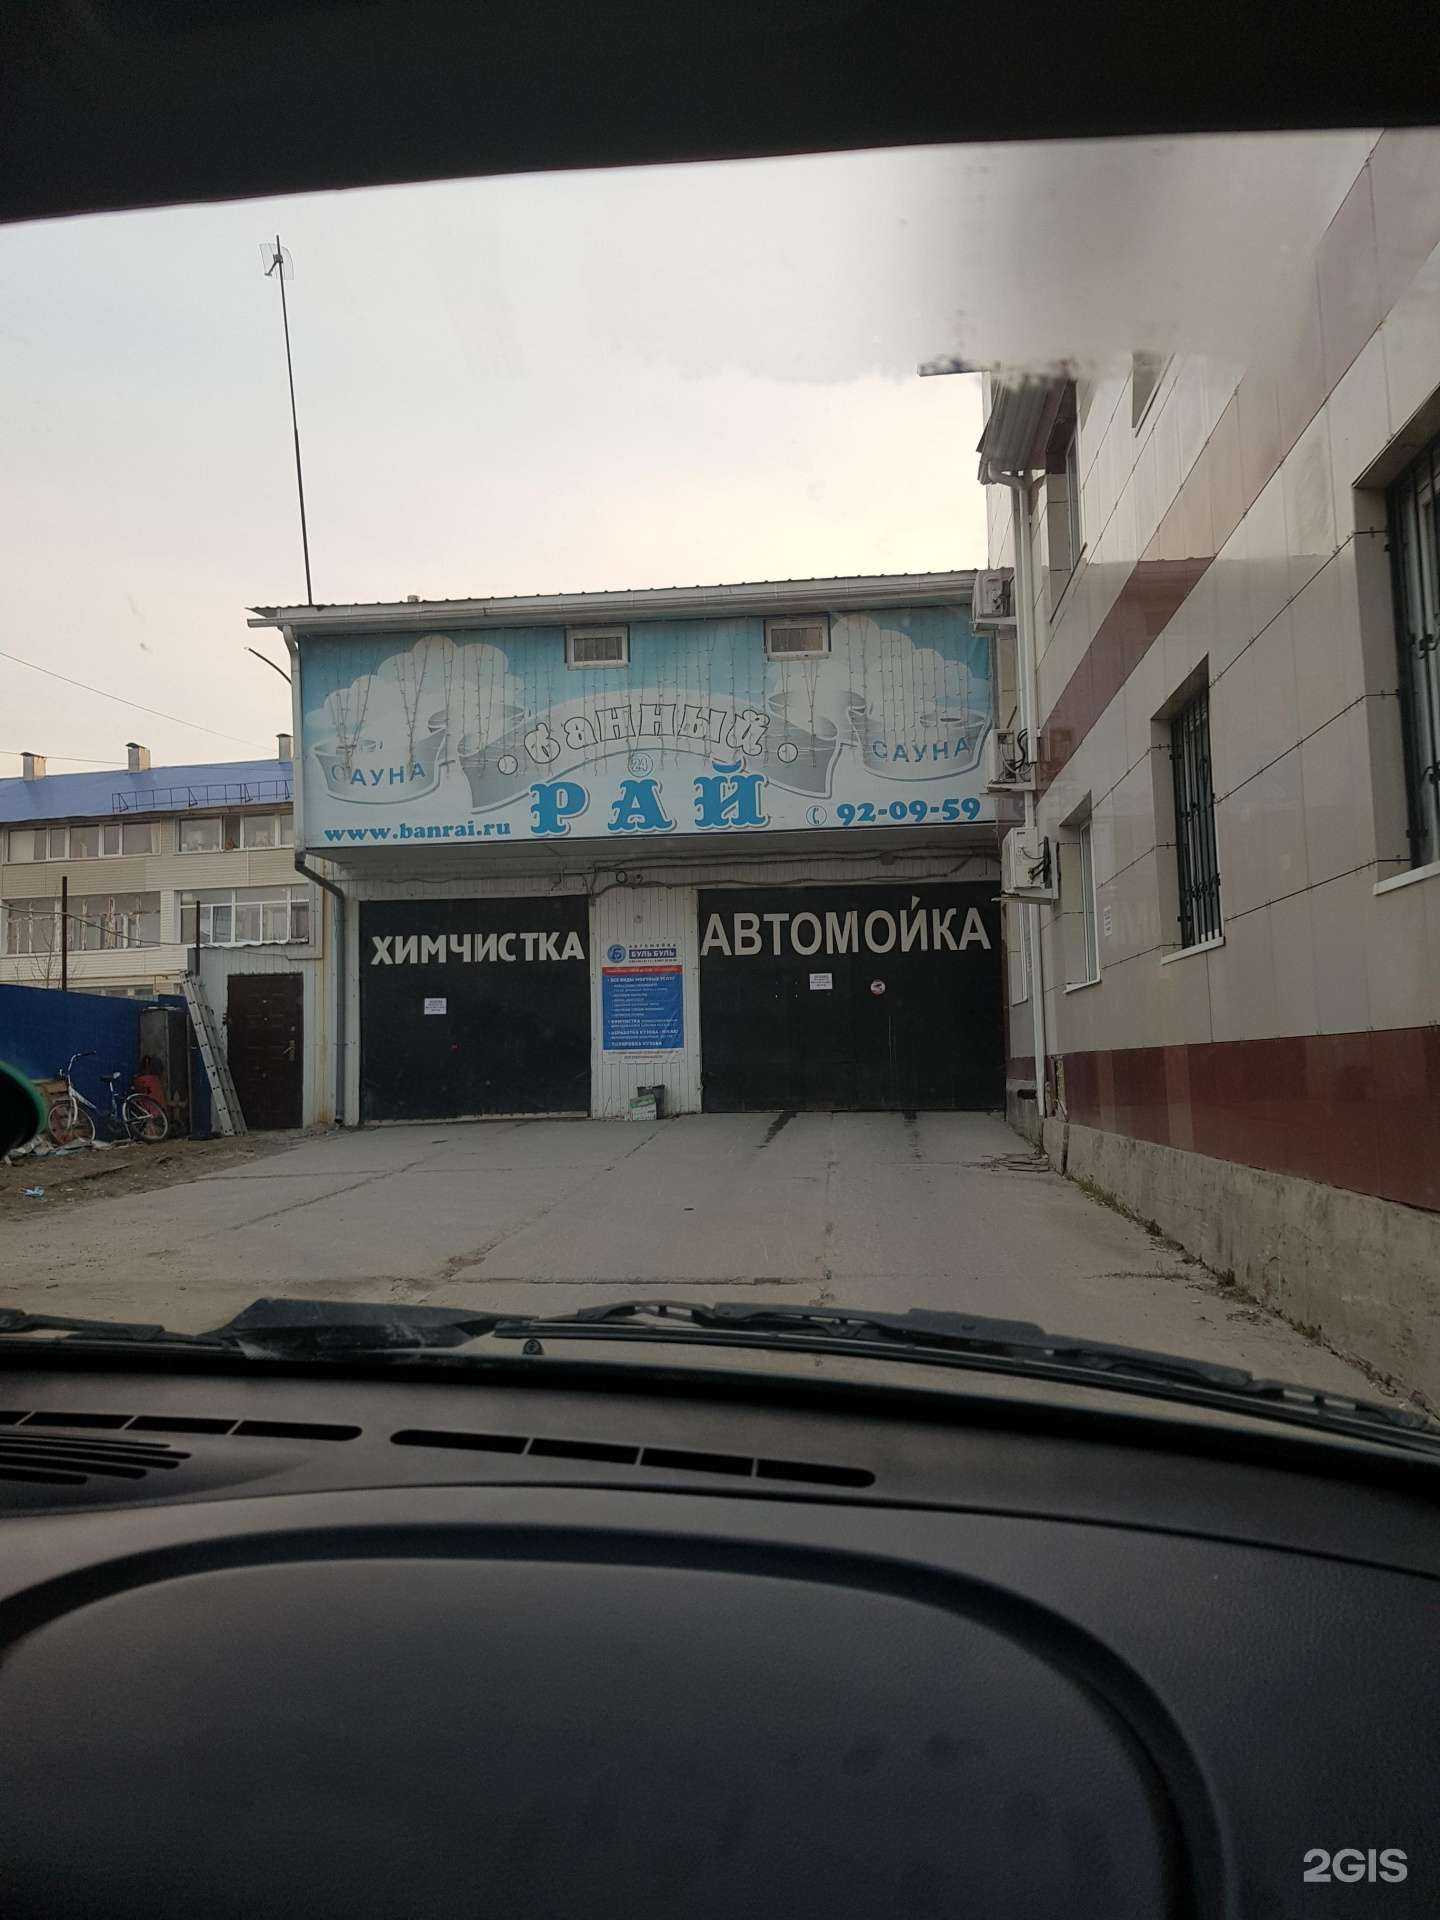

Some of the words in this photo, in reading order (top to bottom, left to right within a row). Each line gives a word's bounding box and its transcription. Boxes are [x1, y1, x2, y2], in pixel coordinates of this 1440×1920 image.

[872, 740, 977, 763] САУНА
[331, 761, 426, 786] САУНА
[529, 756, 767, 836] РАЙ
[836, 798, 981, 826] 92-09-59
[324, 820, 511, 843] www.banrai.ru
[700, 895, 992, 956] АВТОМОЙКА
[370, 931, 586, 965] ХИМЧИСТКА
